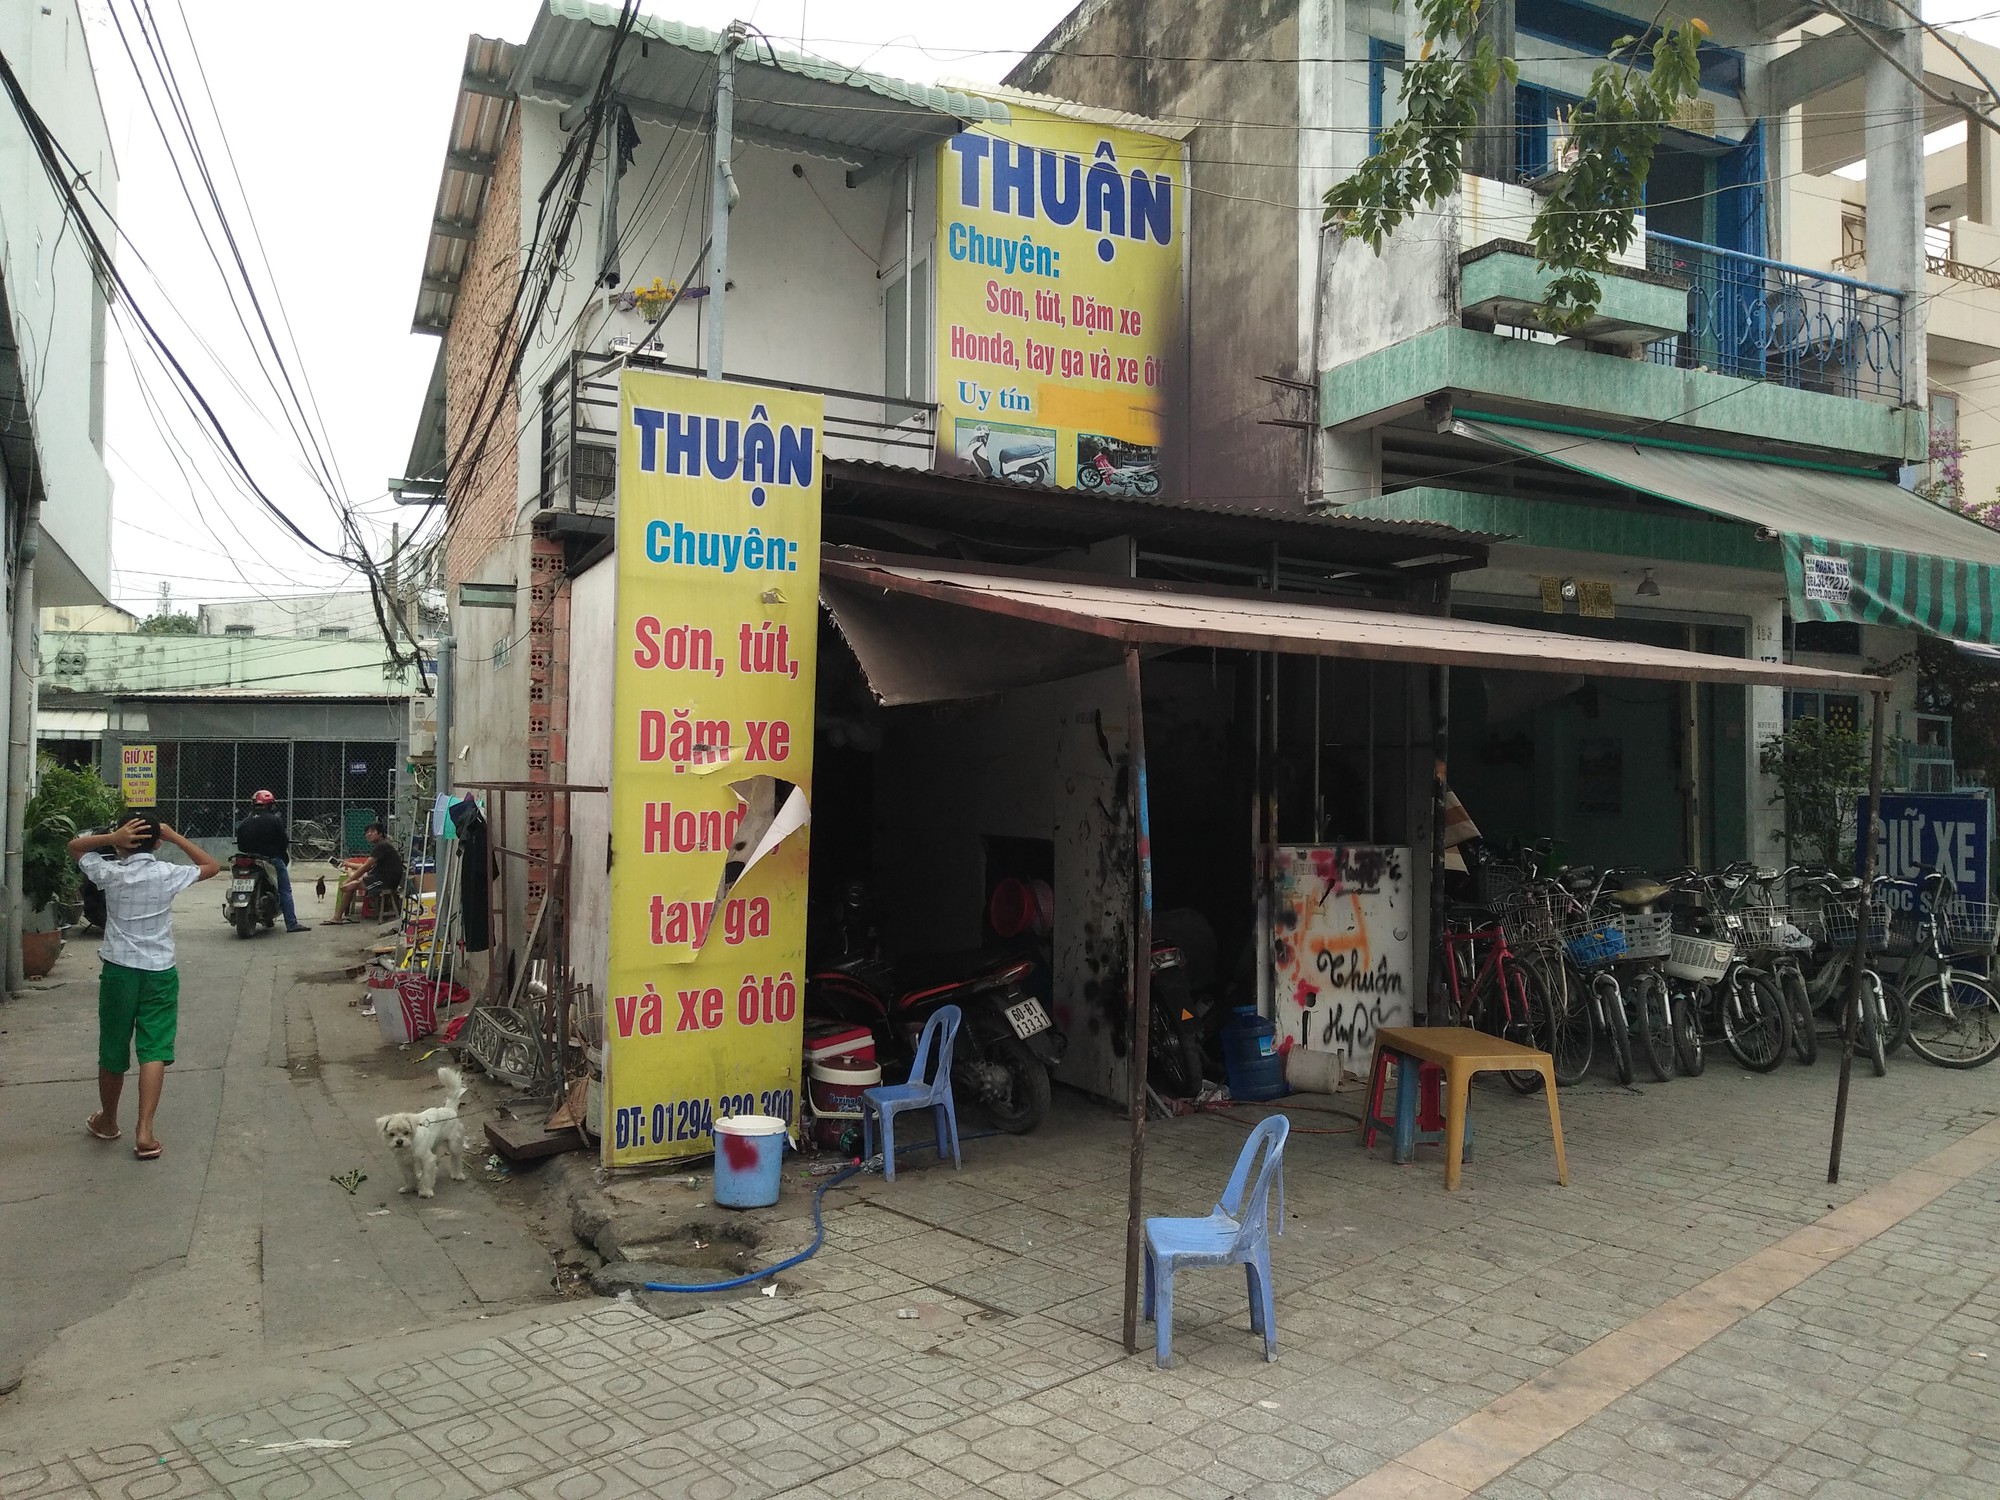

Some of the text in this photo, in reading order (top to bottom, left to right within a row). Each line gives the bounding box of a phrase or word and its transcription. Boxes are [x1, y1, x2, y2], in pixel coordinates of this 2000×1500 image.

[951, 132, 1171, 262] THUẬN
[949, 222, 1060, 278] Chuyên:
[986, 280, 1141, 336] Sơn, tút, Dặm xe
[951, 325, 1020, 371] Honda,
[1026, 338, 1055, 376] tay
[1061, 349, 1083, 378] ga
[1090, 348, 1111, 380] và
[1117, 356, 1139, 384] xe
[958, 381, 1031, 411] Uy tín
[633, 404, 814, 507] THUẬN
[646, 520, 798, 573] Chuyên:
[634, 616, 799, 679] Sơn, tút,
[142, 750, 154, 764] XE
[639, 708, 790, 774] Dặm xe
[1933, 820, 1976, 884] XE
[649, 896, 770, 950] tay ga
[615, 971, 796, 1038] và xe ôtô
[1011, 1001, 1038, 1022] 60-B1
[1016, 1012, 1049, 1037] 133.31
[615, 1105, 645, 1150] ĐT:
[651, 1098, 712, 1145] 01294
